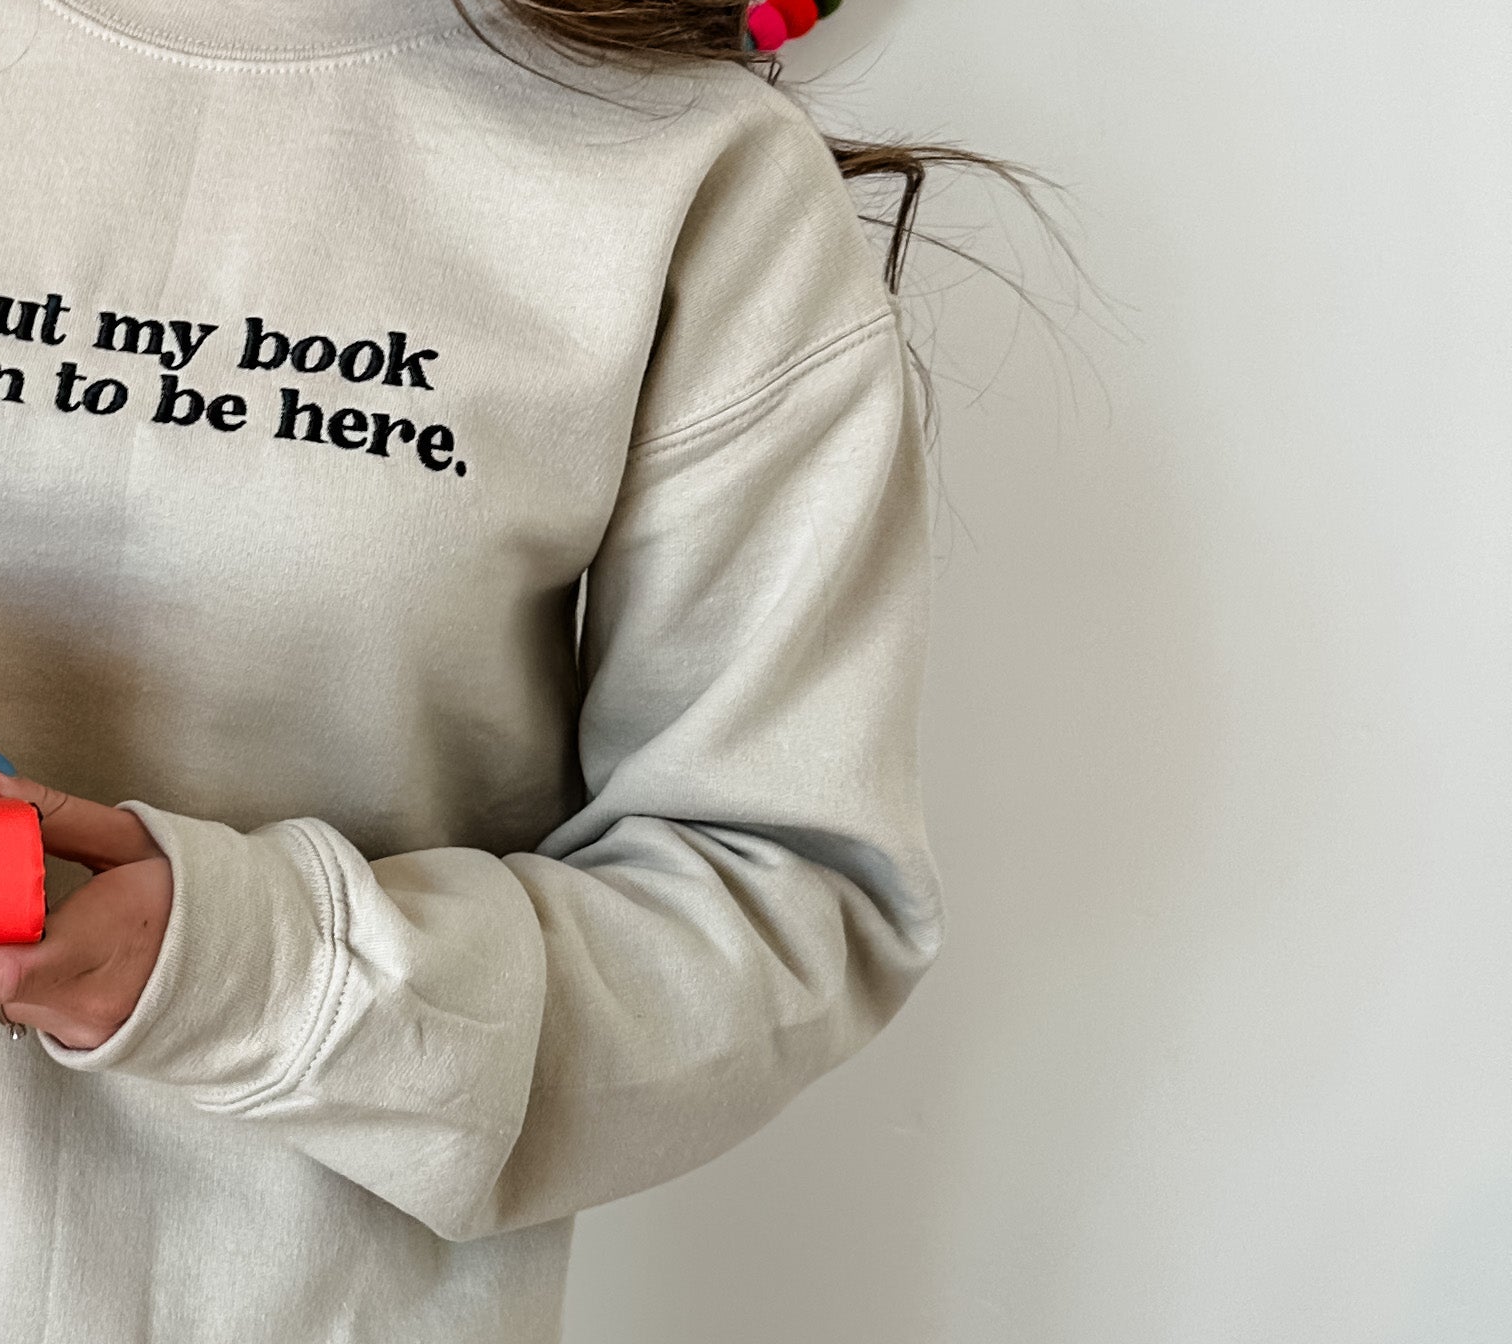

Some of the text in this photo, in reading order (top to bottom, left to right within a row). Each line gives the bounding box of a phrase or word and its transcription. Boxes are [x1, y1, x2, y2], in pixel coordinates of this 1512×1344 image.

[93, 310, 219, 370] my
[237, 317, 439, 391] book
[54, 361, 129, 415] to
[152, 374, 248, 432] be
[274, 388, 468, 477] here.
